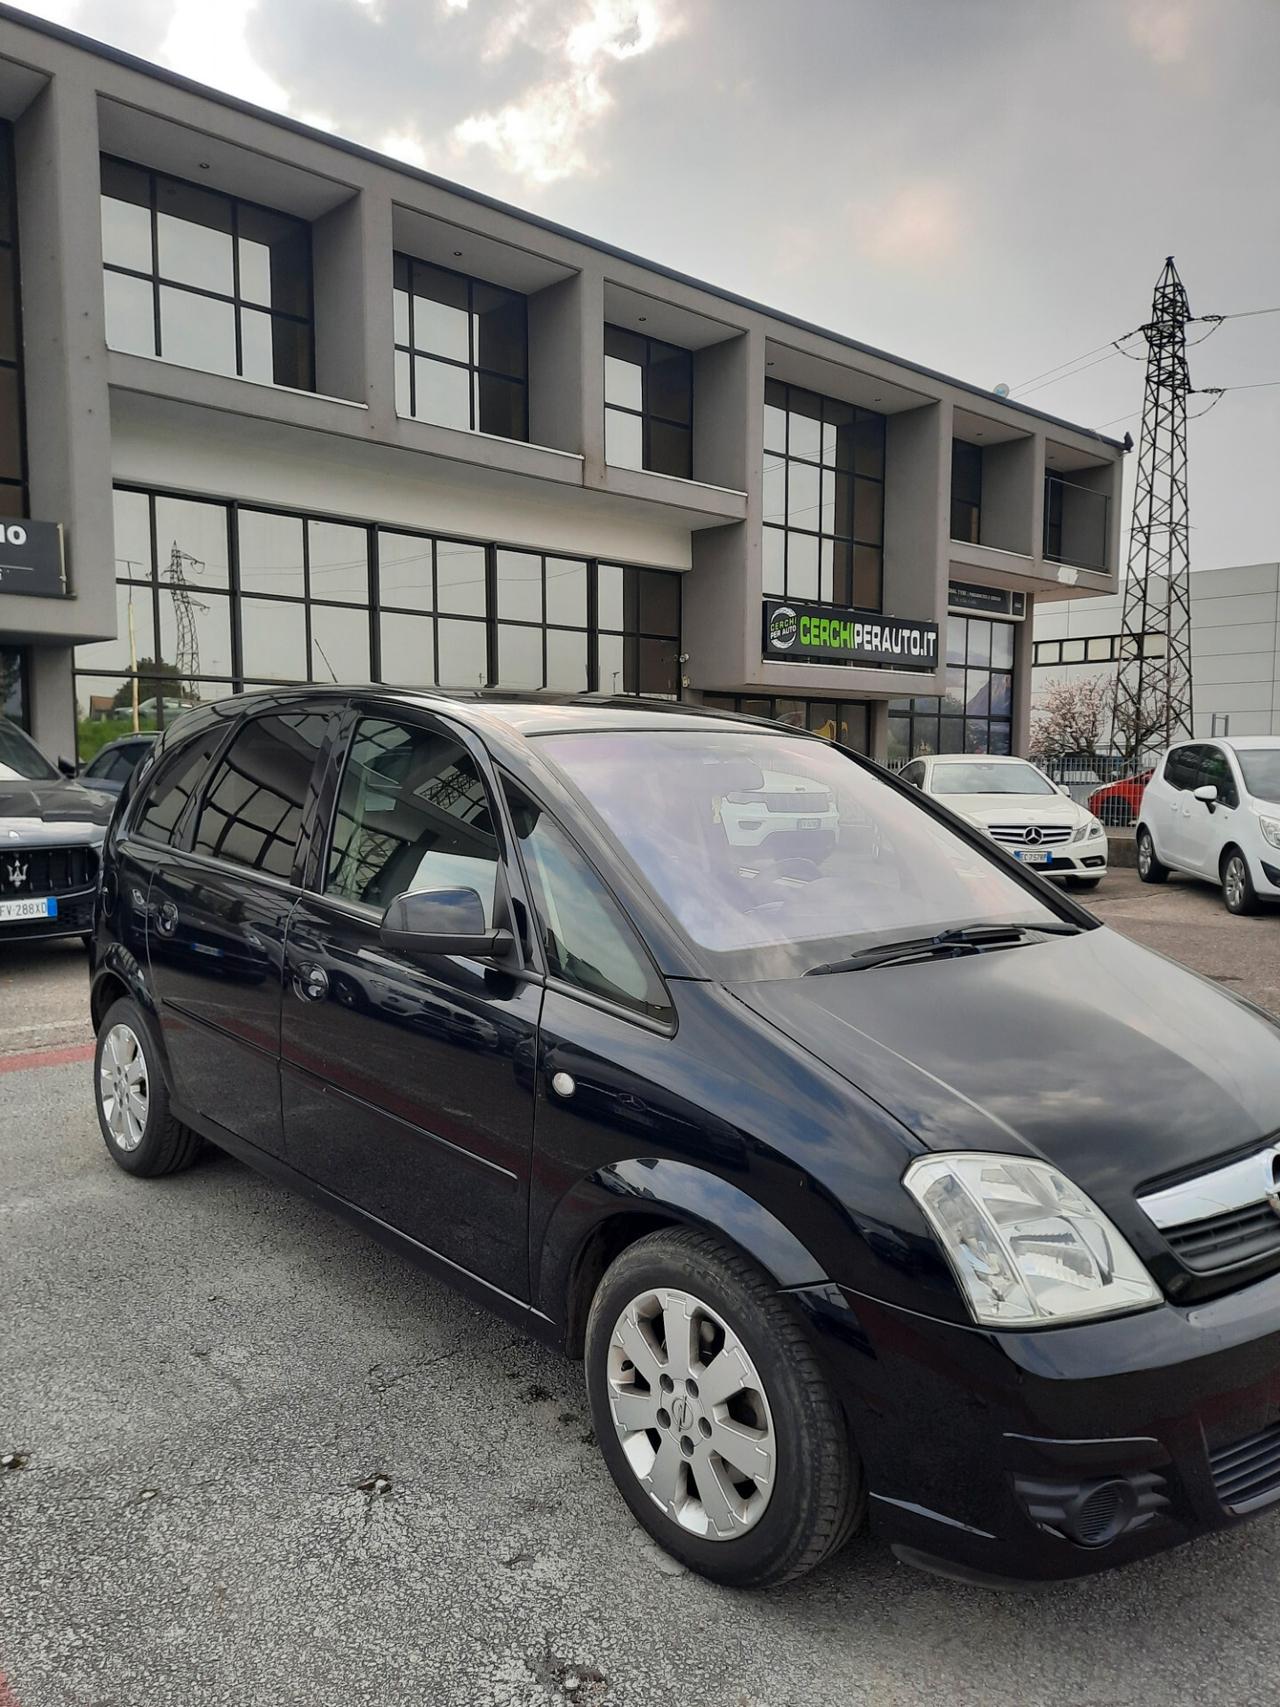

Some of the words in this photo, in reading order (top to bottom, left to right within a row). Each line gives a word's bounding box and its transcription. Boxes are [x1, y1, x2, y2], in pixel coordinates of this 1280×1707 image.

[770, 616, 797, 632] CERCHI
[770, 629, 781, 640] PER
[781, 625, 797, 636] AUTO
[800, 615, 937, 657] CERCHIPERAUTO.IT
